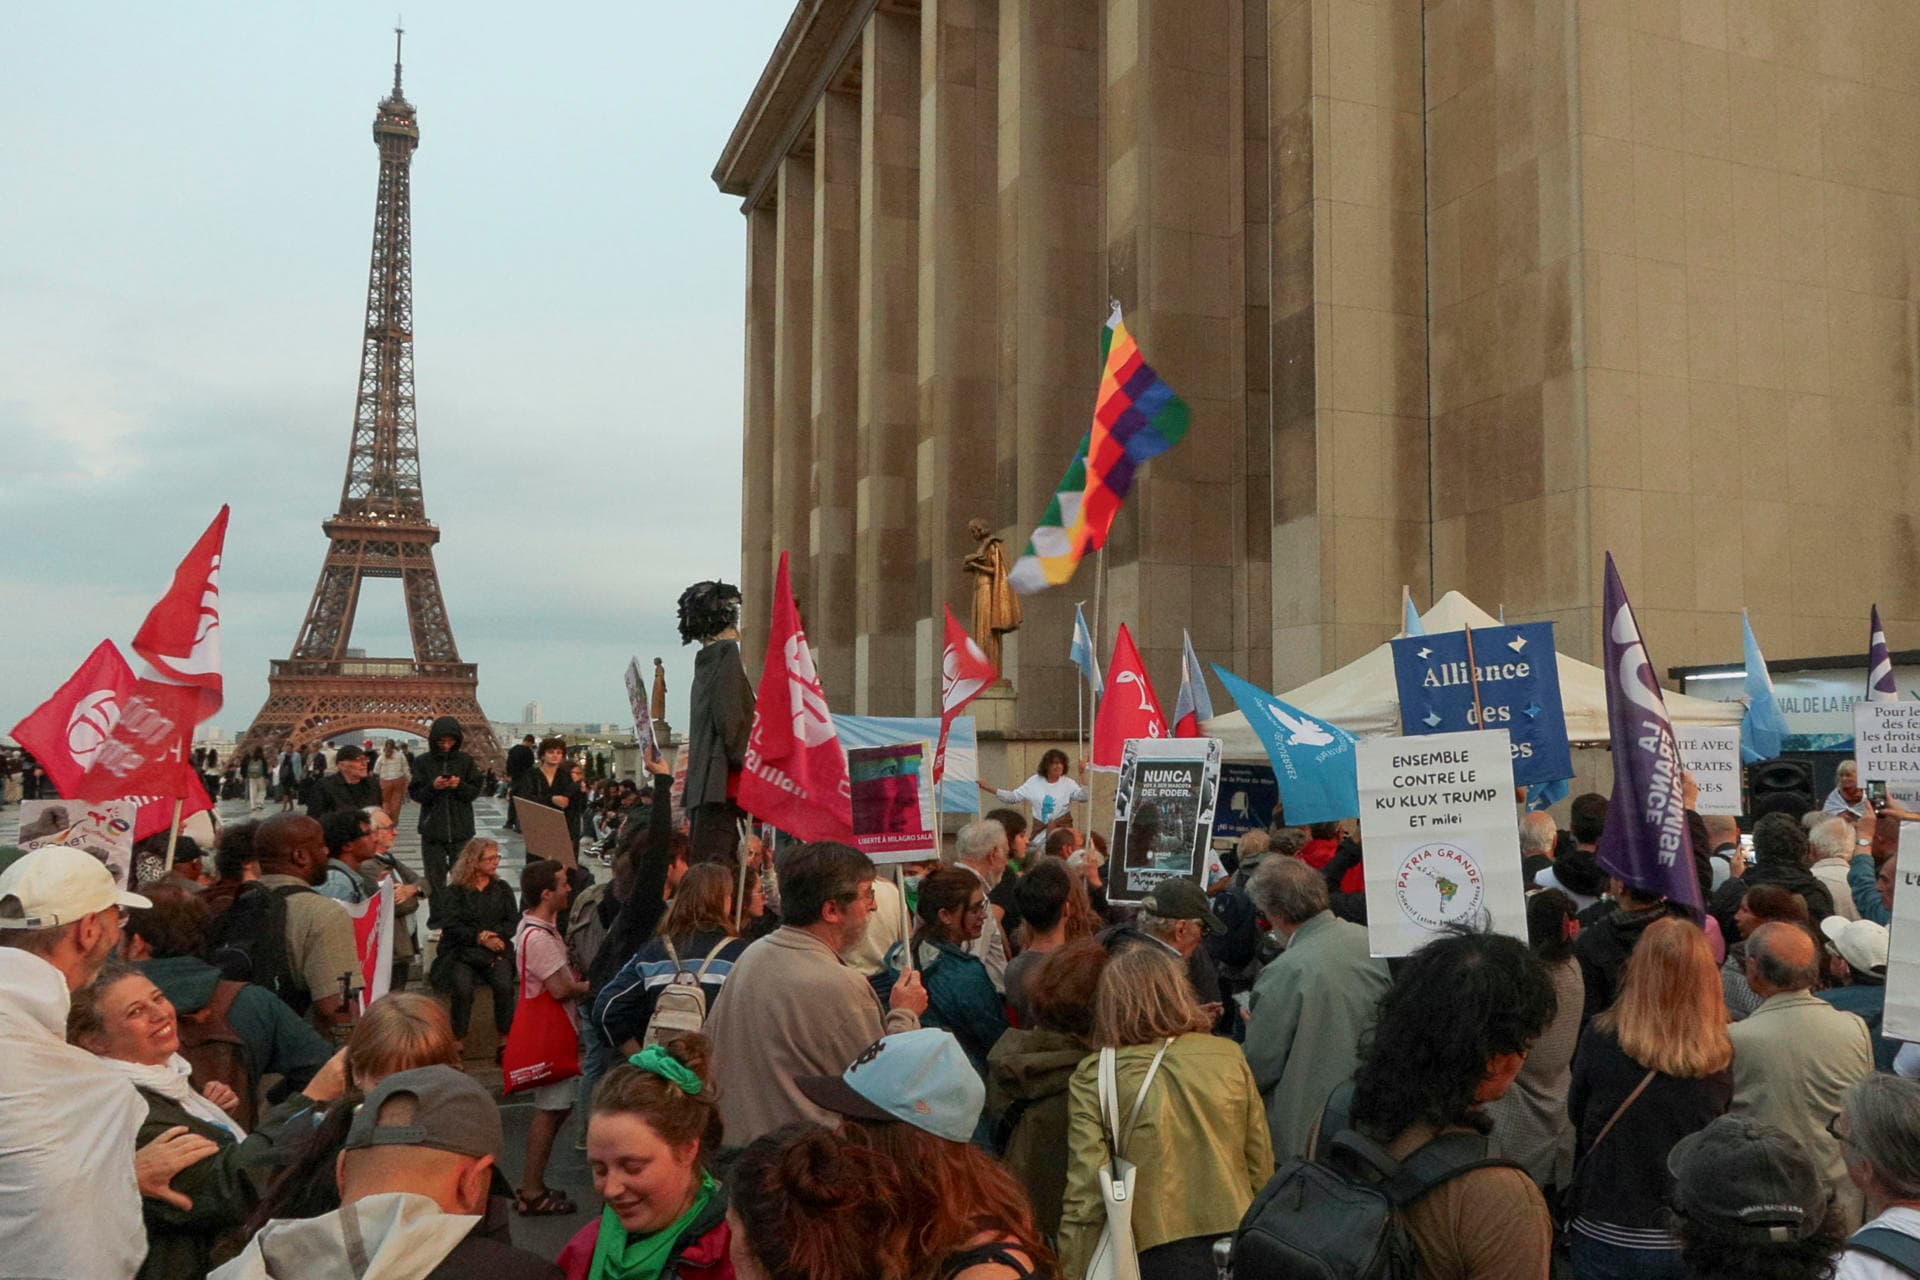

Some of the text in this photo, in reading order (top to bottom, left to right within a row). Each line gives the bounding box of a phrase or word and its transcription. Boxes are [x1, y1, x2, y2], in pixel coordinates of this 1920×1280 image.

[1422, 661, 1530, 687] Alliance
[1803, 697, 1819, 713] DE
[1822, 696, 1839, 713] LA
[1466, 702, 1512, 725] des
[1875, 707, 1906, 717] Pour
[1881, 719, 1920, 729] des fe
[1863, 731, 1920, 741] les droits
[1700, 741, 1733, 751] AVEC
[1870, 744, 1882, 753] et
[1886, 743, 1897, 753] la
[1392, 750, 1469, 768] ENSEMBLE
[1867, 761, 1920, 771] FUERA
[1143, 770, 1193, 783] NUNCA
[1393, 770, 1476, 788] CONTRE LE
[1141, 789, 1158, 797] DEL
[1376, 789, 1497, 809] KU KLUX TRUMP
[1409, 813, 1462, 827] ET milei
[1398, 848, 1480, 889] PATRIA GRANDE
